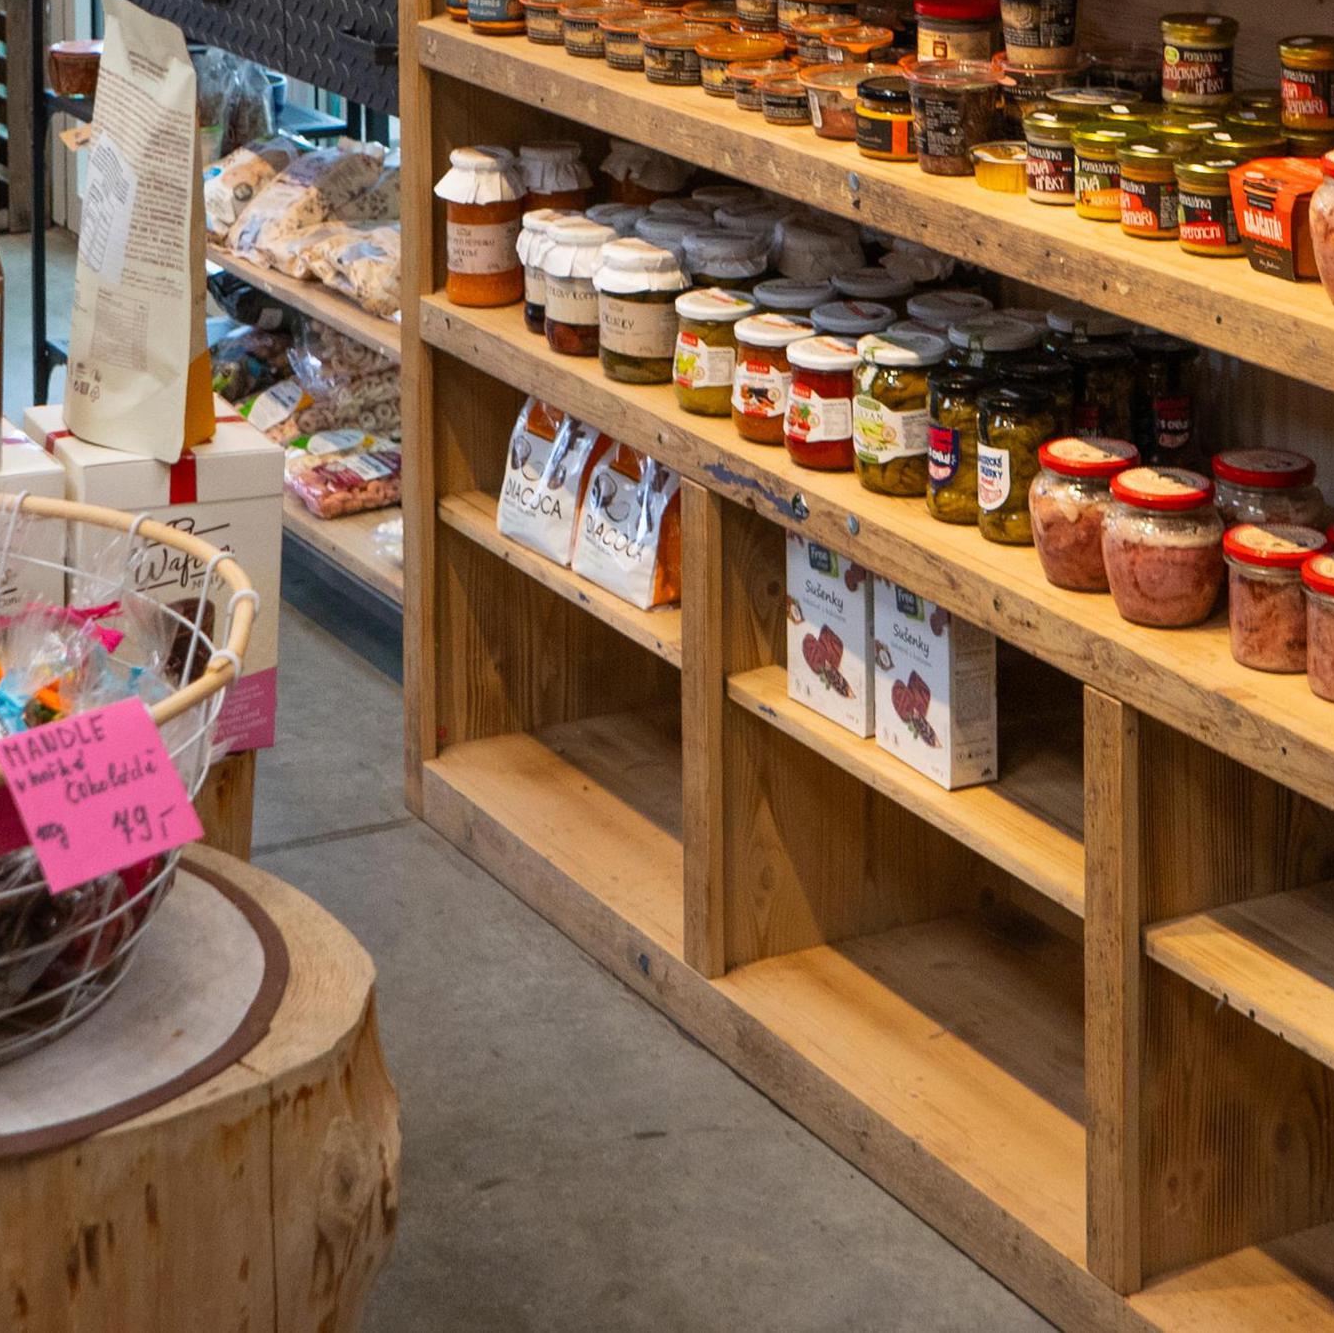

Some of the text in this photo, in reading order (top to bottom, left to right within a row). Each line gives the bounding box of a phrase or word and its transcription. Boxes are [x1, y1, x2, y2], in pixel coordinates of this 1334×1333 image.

[804, 579, 845, 612] Sušenky
[893, 622, 931, 658] Sušenky
[2, 714, 107, 767] MANDLE
